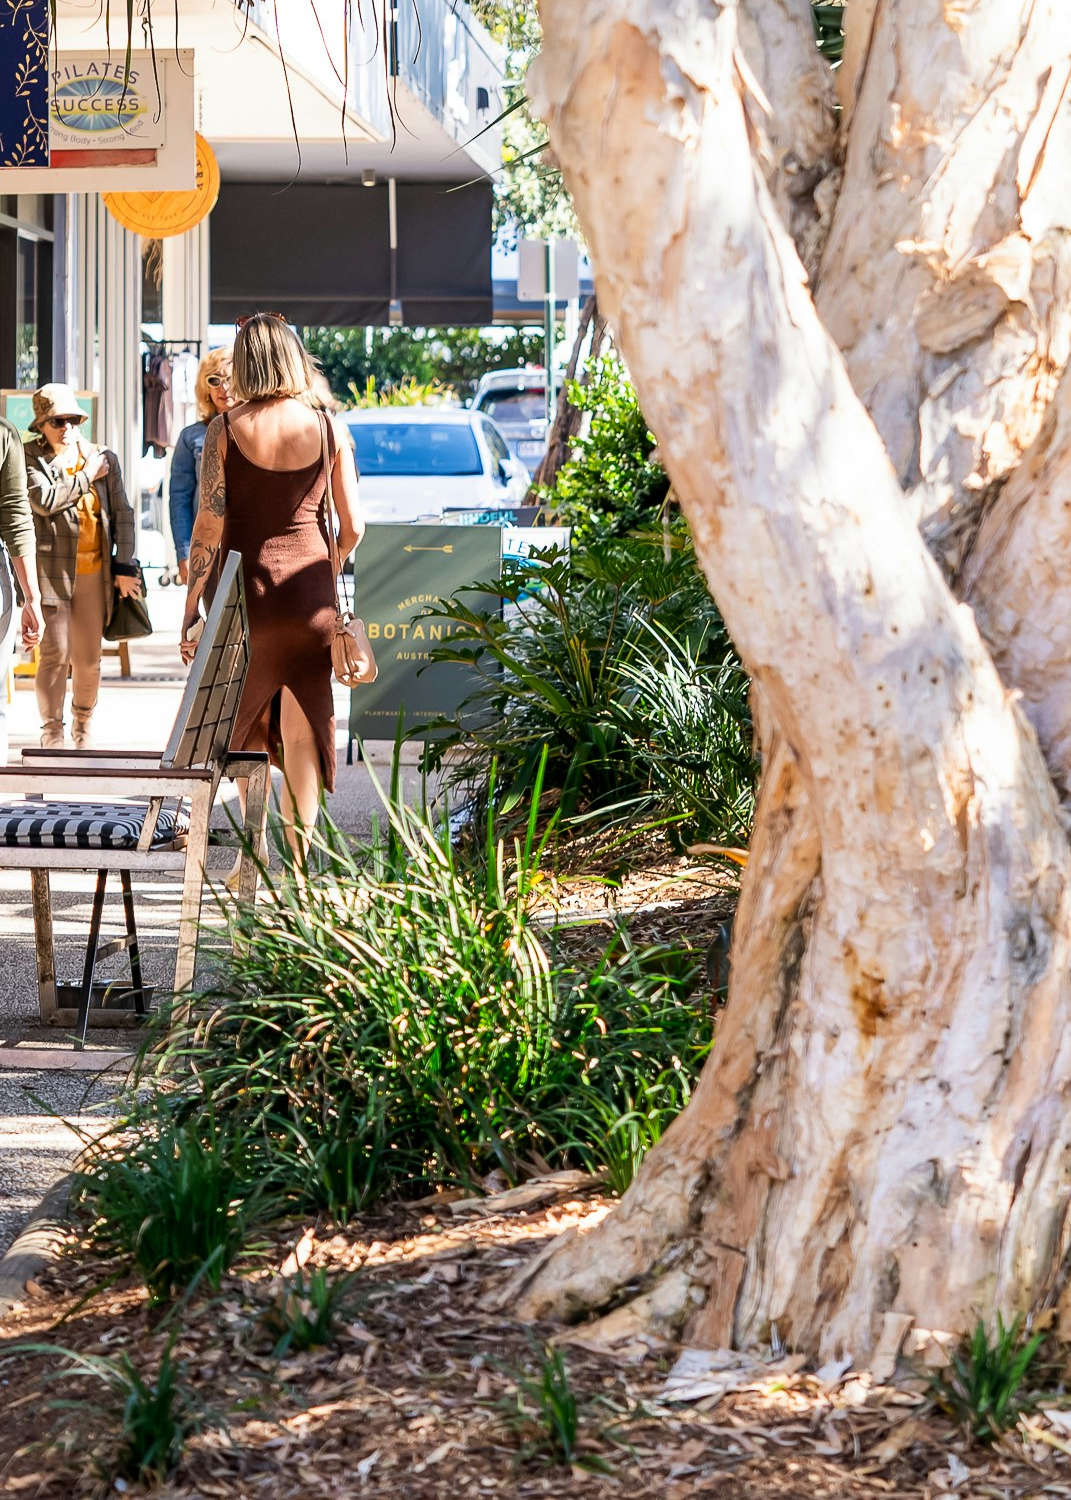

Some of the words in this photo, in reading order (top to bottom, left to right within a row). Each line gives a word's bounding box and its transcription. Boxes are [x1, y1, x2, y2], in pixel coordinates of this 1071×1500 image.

[50, 62, 141, 85] PILATES
[50, 98, 140, 113] SUCCESS
[69, 133, 91, 146] Body
[96, 131, 126, 145] Strong
